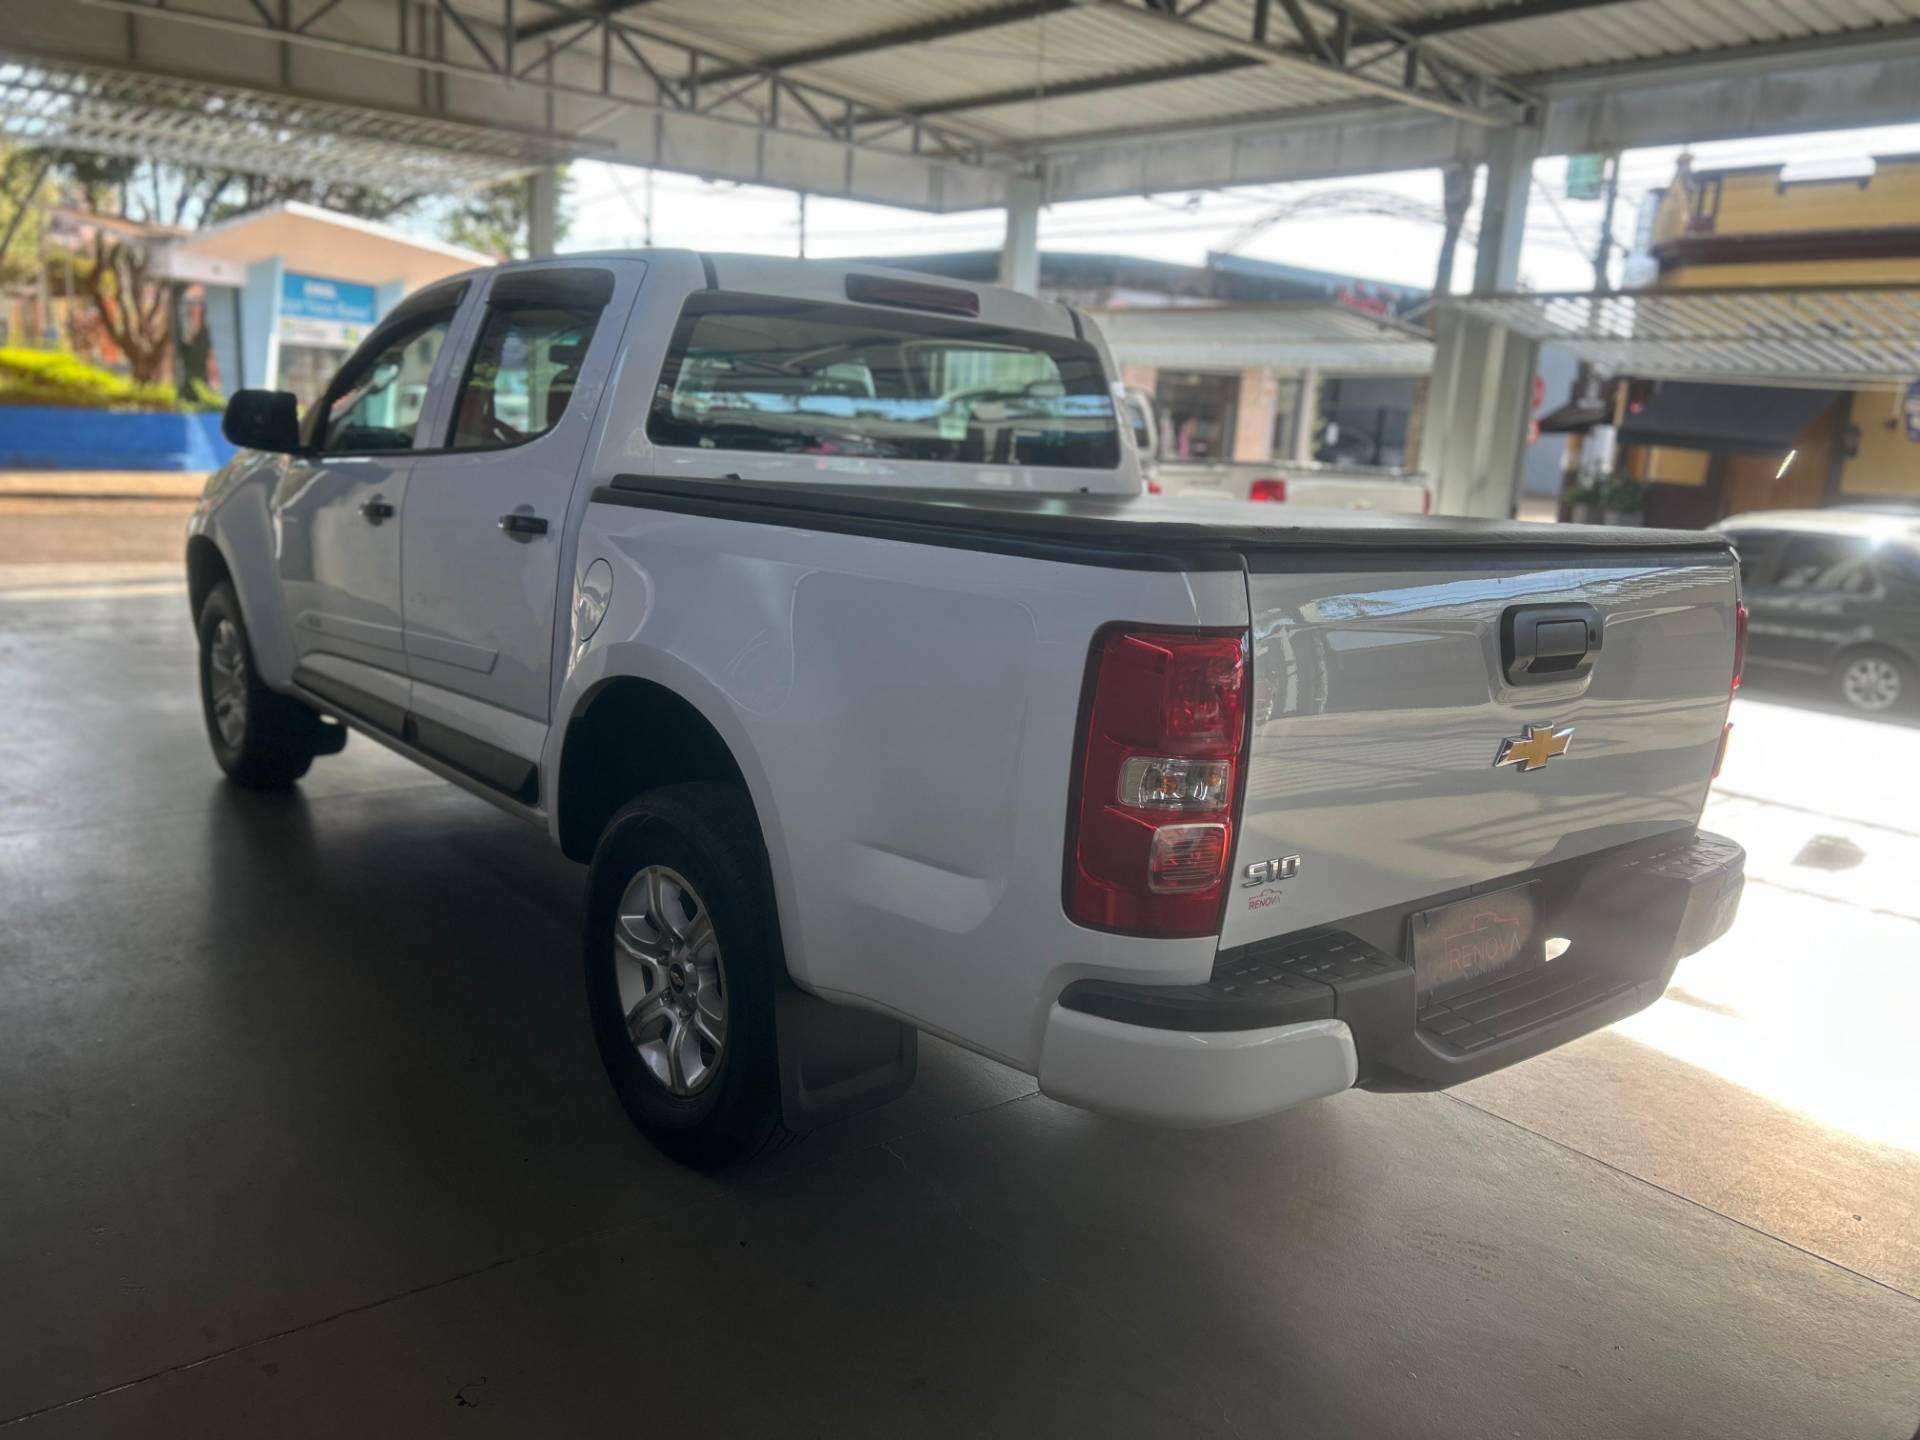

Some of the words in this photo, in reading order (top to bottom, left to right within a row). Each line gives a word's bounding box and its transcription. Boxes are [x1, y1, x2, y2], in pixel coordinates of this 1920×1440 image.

[1242, 854, 1301, 888] S10
[1248, 896, 1281, 910] RENOVA
[1449, 931, 1522, 970] RENOVA
